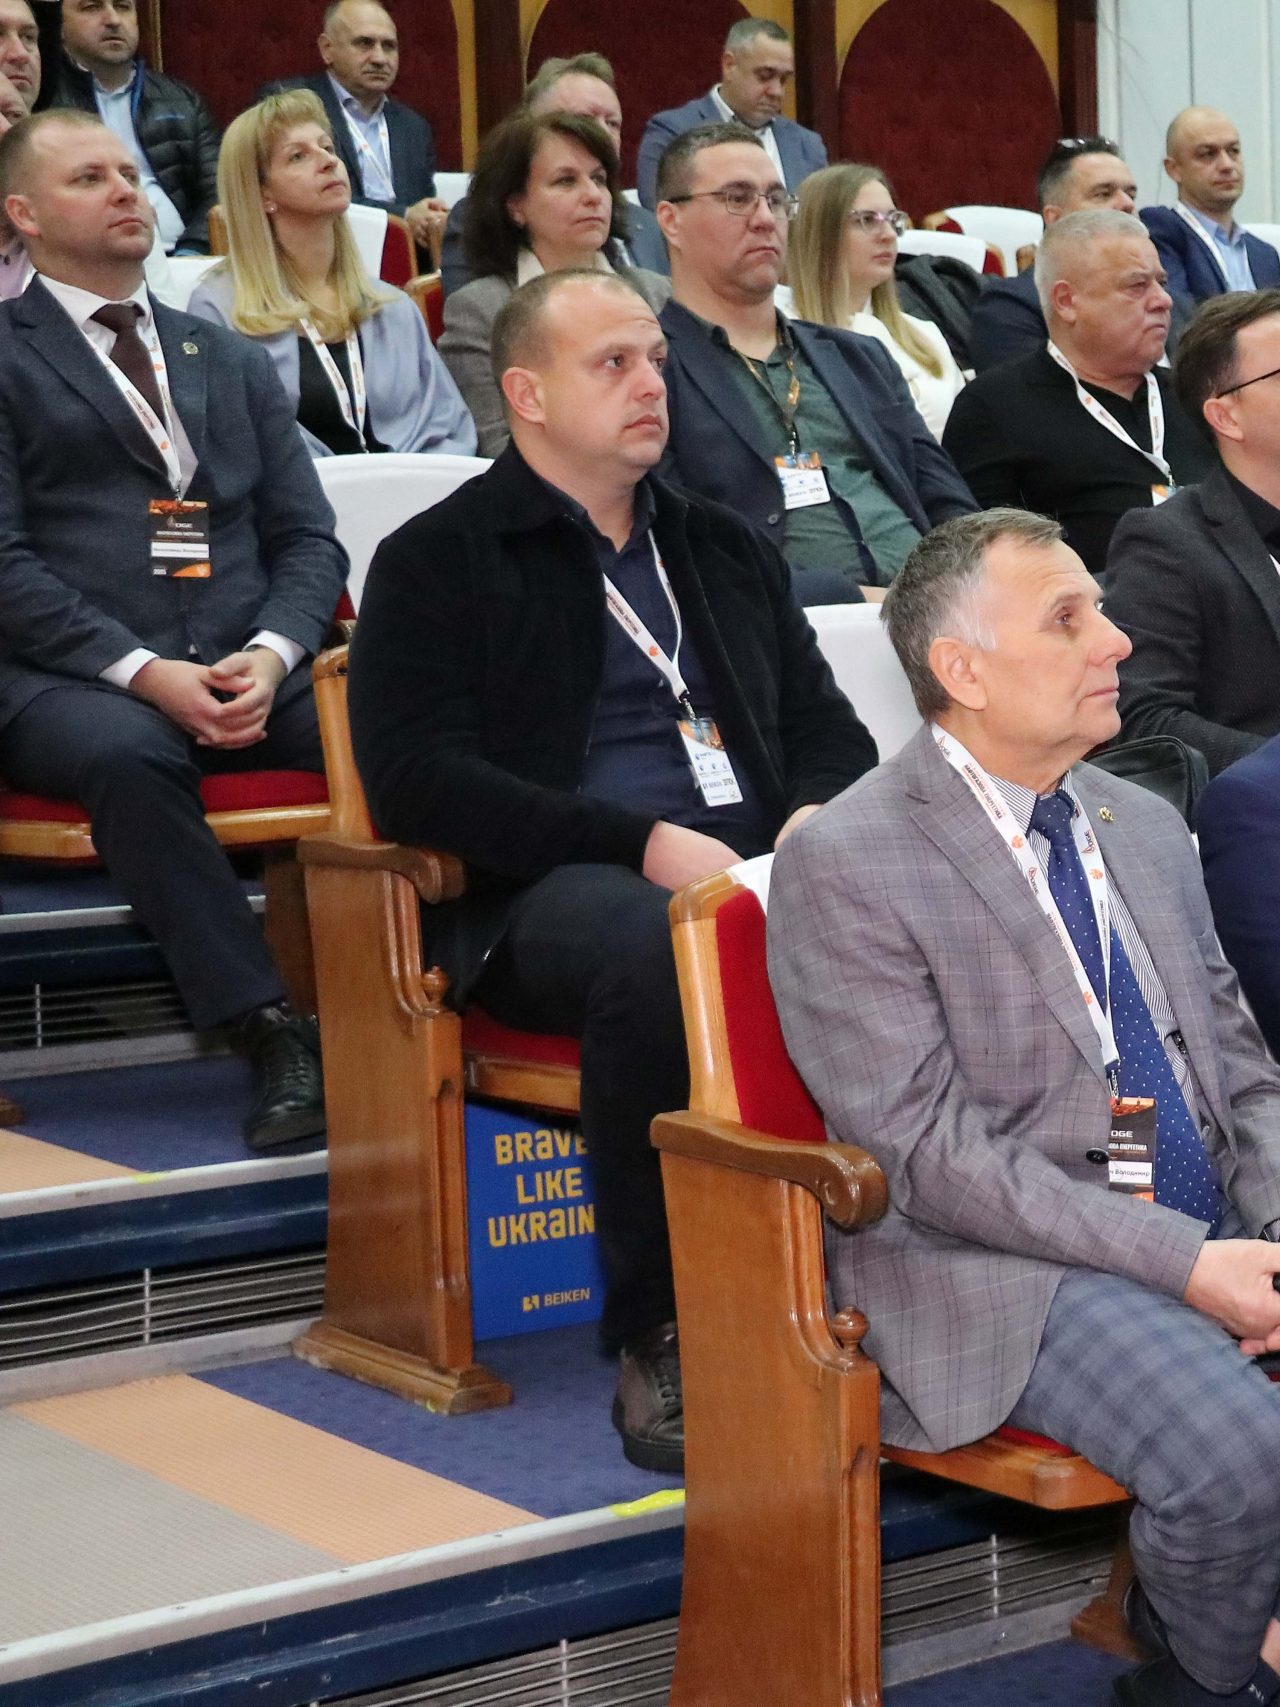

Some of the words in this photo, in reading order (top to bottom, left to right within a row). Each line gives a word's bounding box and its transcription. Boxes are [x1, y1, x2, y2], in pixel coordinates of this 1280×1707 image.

[515, 1166, 584, 1204] LIKE
[488, 1203, 596, 1248] UKRaIN
[544, 1287, 591, 1307] BEIKEN
